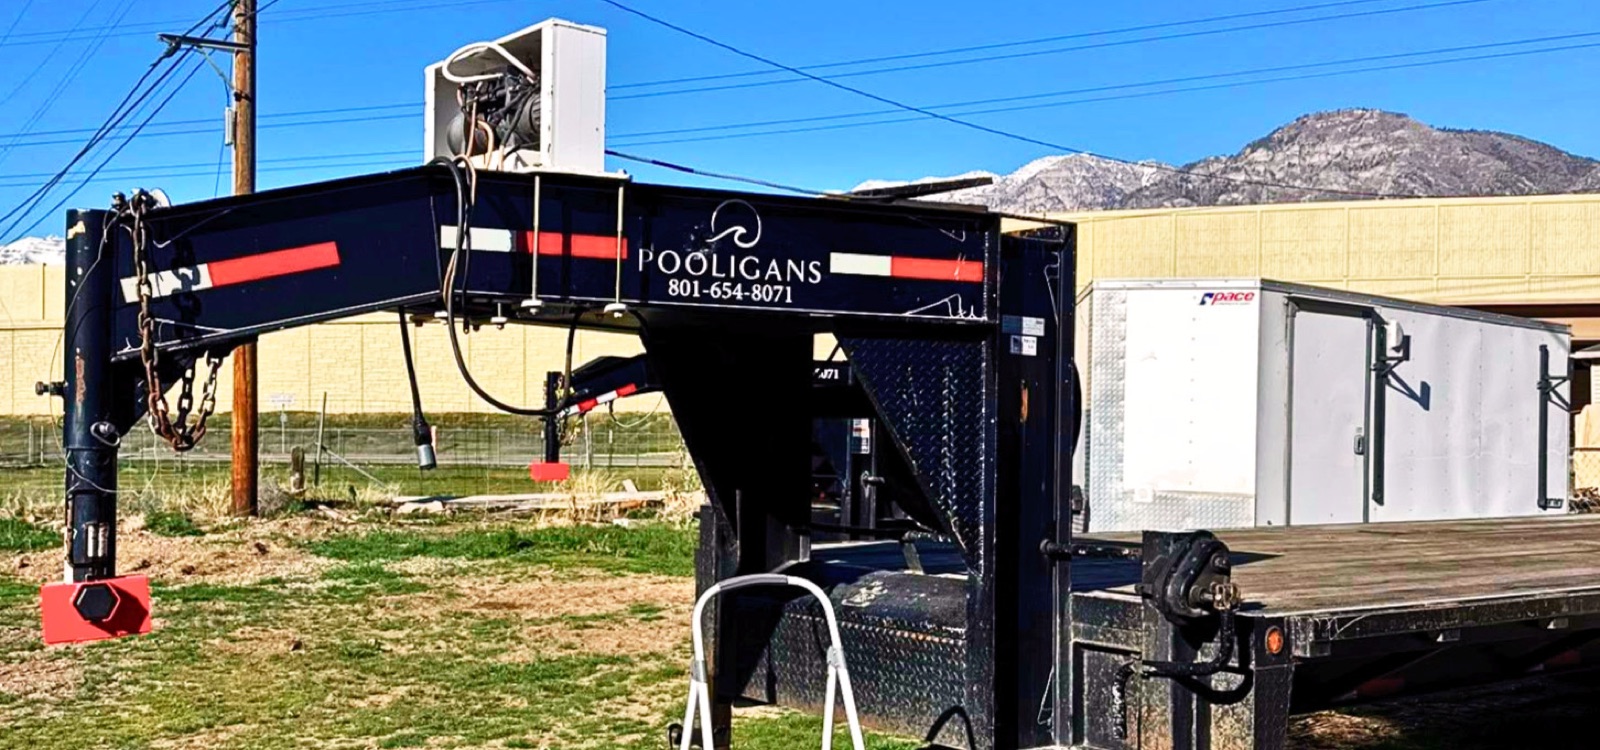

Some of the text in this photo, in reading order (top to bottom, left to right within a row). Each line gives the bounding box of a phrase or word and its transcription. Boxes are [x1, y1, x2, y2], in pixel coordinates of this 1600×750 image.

[638, 248, 822, 284] POOLIGANS
[668, 278, 792, 303] 801-654-8071
[1211, 291, 1255, 306] pace
